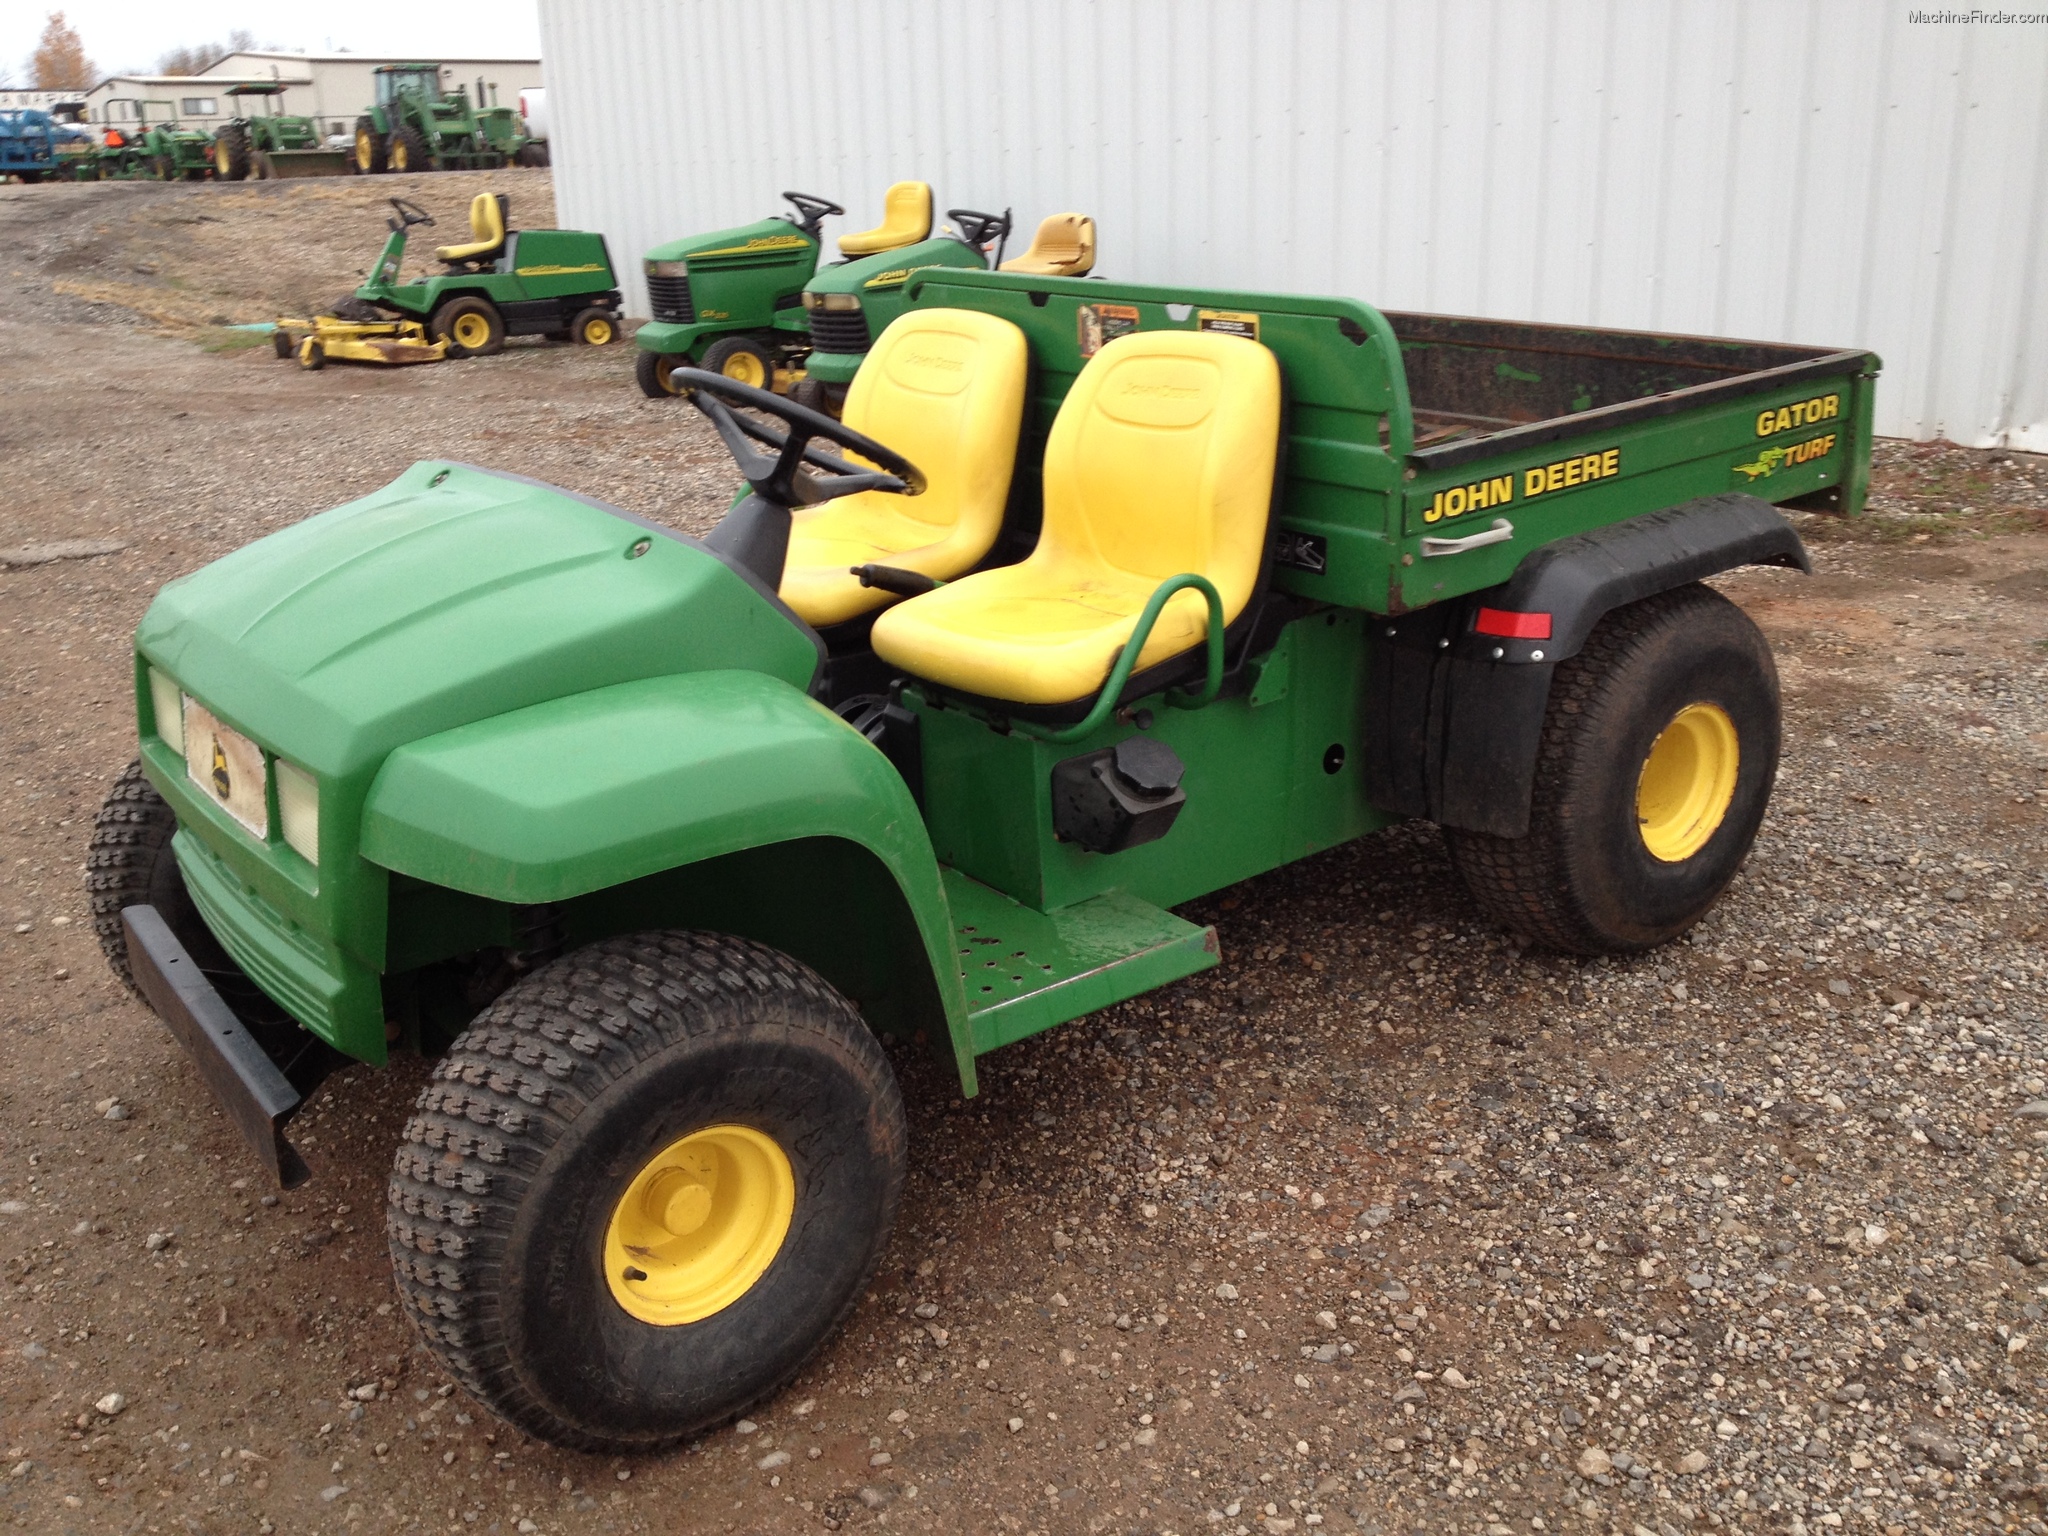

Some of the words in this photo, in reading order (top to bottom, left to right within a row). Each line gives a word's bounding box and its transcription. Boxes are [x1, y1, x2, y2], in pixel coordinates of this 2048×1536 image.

[1756, 394, 1840, 437] GATOR
[1783, 434, 1837, 468] TURF
[1423, 474, 1514, 524] JOHN
[1524, 448, 1621, 498] DEERE
